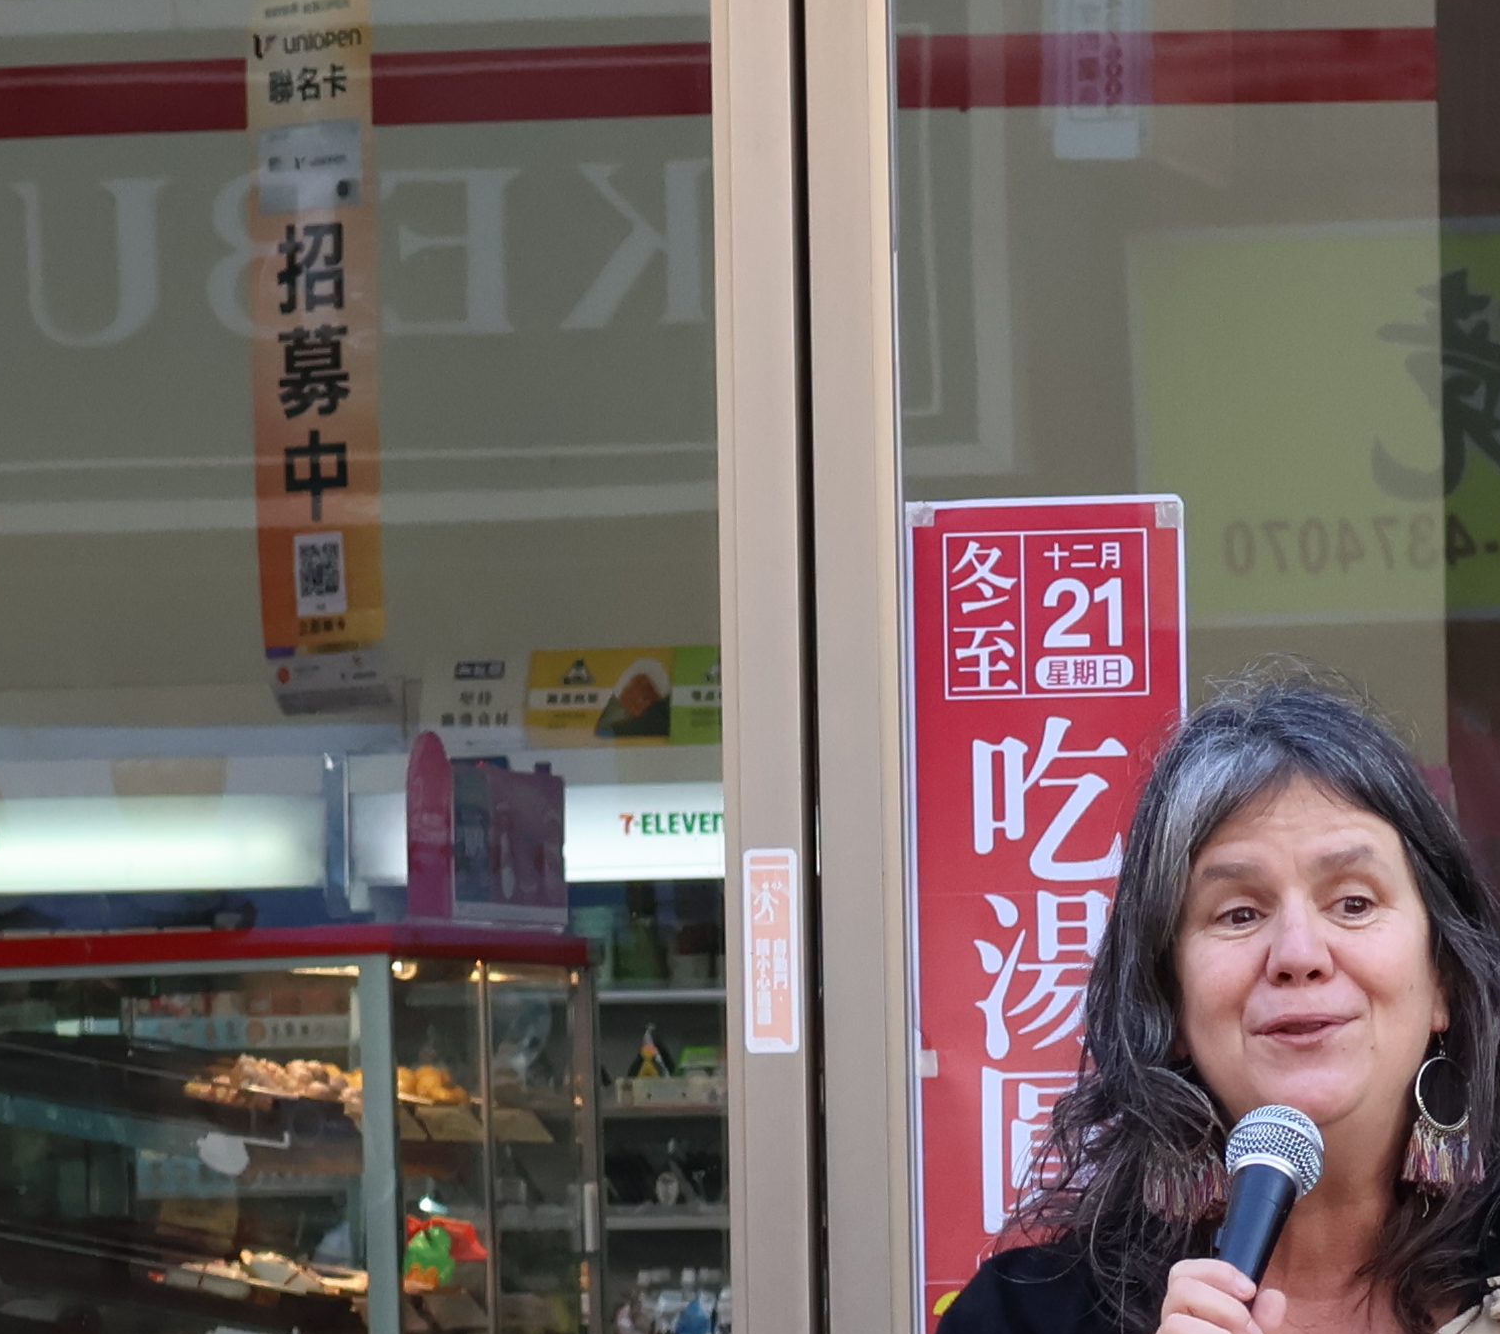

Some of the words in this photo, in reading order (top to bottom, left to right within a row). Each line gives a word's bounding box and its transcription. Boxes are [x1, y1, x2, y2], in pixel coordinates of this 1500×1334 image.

[268, 63, 348, 104] 聯名卡
[277, 221, 350, 523] 招募中
[1043, 541, 1122, 571] 十二月
[950, 540, 1019, 692] 冬至
[1041, 576, 1124, 649] 21
[1046, 658, 1123, 687] 星期日
